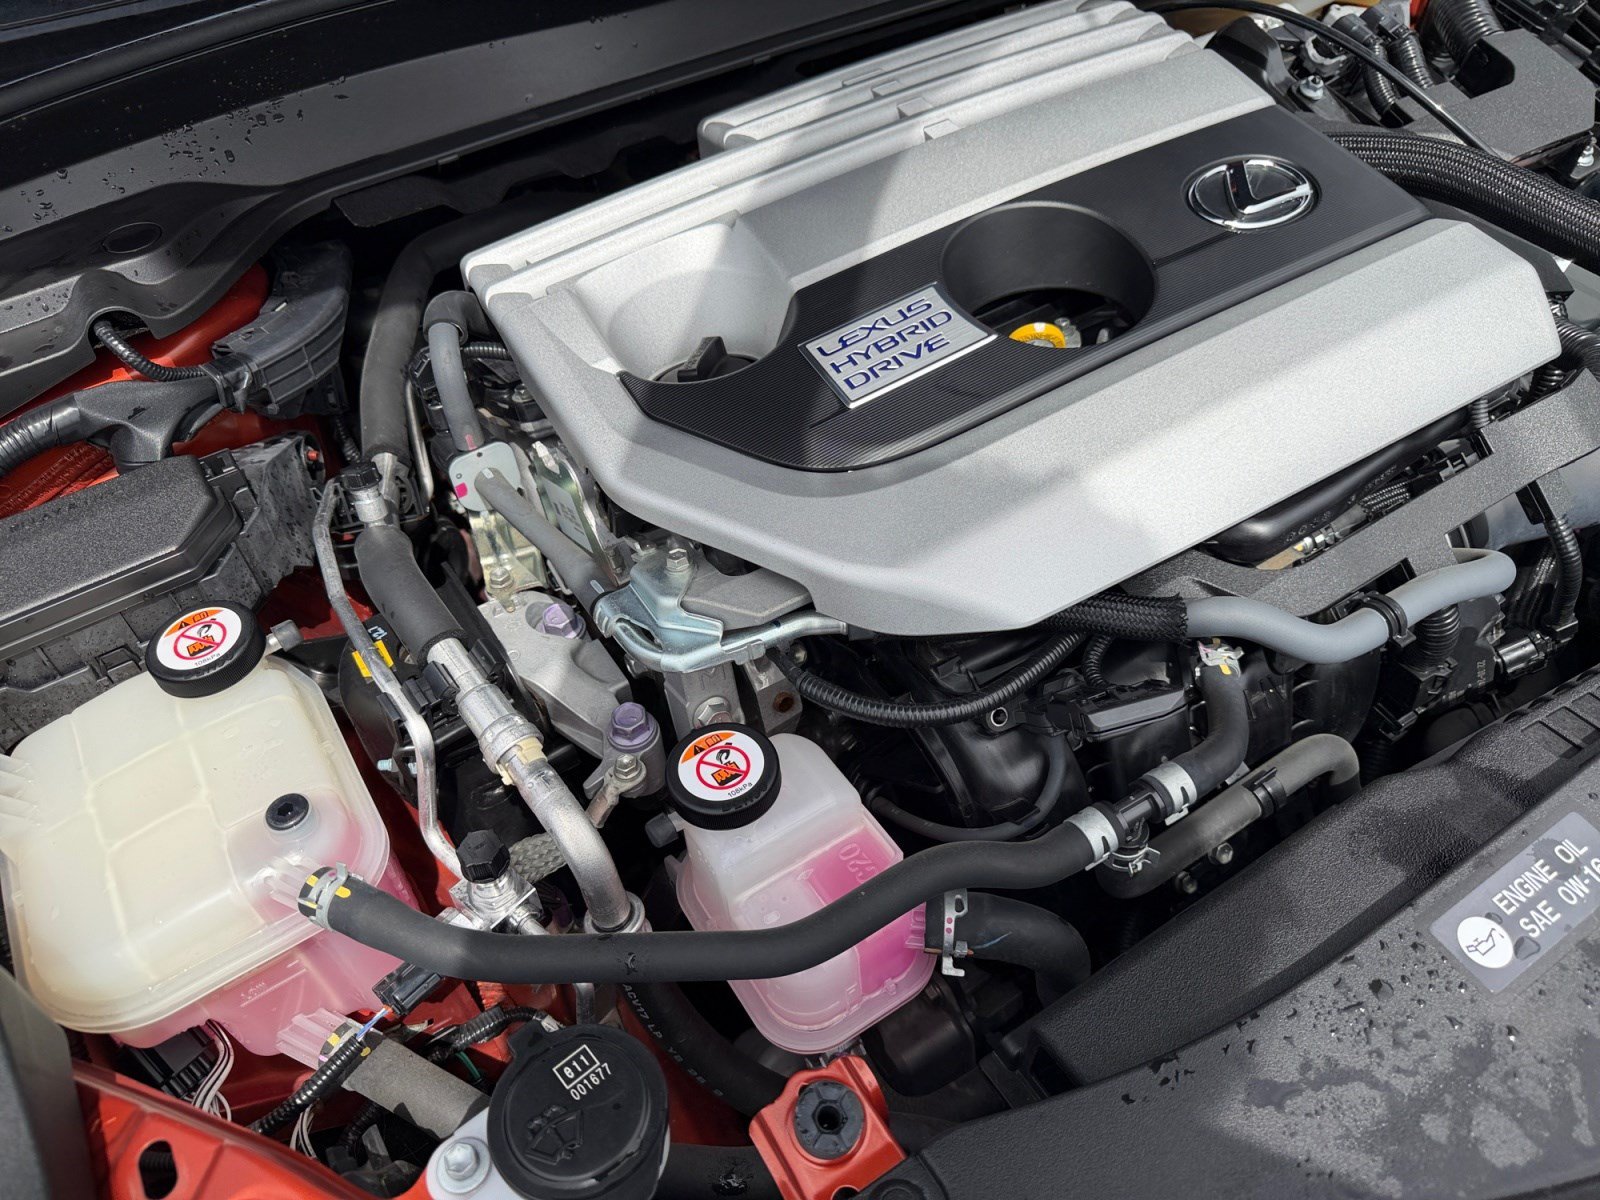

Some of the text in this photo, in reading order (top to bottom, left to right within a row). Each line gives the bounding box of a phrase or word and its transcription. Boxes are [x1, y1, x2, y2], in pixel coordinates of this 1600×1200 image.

[816, 297, 933, 357] LEXUS
[829, 308, 953, 374] HYBRID
[843, 333, 950, 391] DRIVE
[727, 781, 753, 798] 108kPa
[1491, 838, 1589, 916] ENGINE OIL
[1519, 900, 1562, 938] SAE
[562, 1055, 591, 1079] e11
[569, 1062, 613, 1101] 001677
